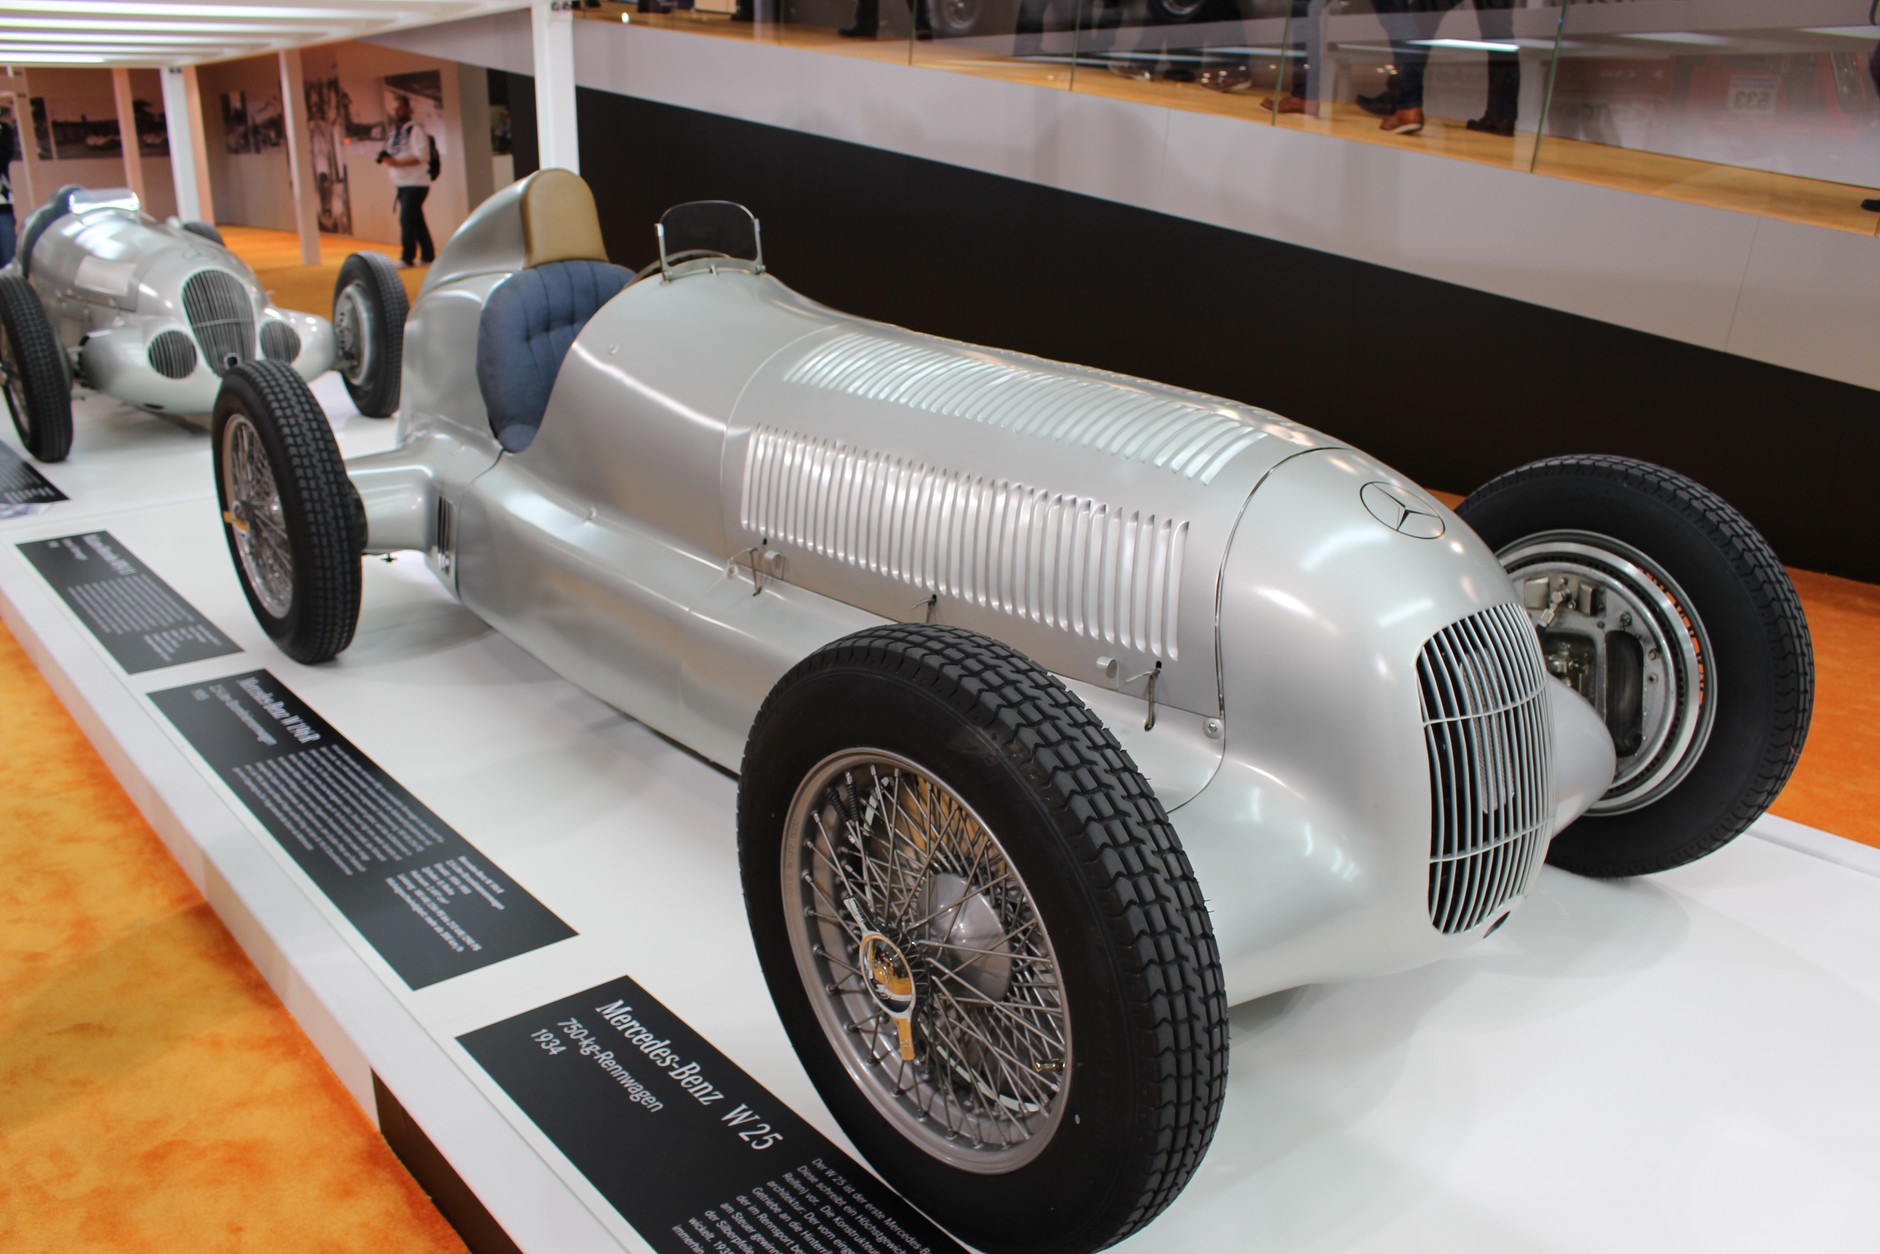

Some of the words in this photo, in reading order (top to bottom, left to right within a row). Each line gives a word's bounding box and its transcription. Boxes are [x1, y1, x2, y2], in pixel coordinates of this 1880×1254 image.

[530, 1028, 567, 1056] 1934
[556, 1017, 664, 1113] 750-kg-Rennwagen
[595, 999, 724, 1106] Mercedes-Benz
[752, 1187, 783, 1214] Getriebe
[778, 1212, 792, 1223] an
[788, 1221, 803, 1233] die
[767, 1180, 807, 1215] architektur:
[803, 1212, 821, 1226] Der
[817, 1225, 836, 1240] vorn
[782, 1172, 808, 1195] Reifen)
[805, 1191, 821, 1206] vor.
[820, 1205, 836, 1218] Die
[797, 1165, 819, 1183] Diese
[816, 1182, 847, 1207] schreibt
[843, 1204, 858, 1216] ein
[812, 1158, 828, 1171] Der
[825, 1168, 838, 1178] W
[832, 1175, 847, 1186] 25
[843, 1184, 856, 1194] ist
[852, 1192, 867, 1203] der
[865, 1203, 886, 1220] erste
[883, 1217, 932, 1254] Mercedes-B
[688, 1217, 716, 1242] wickelt.
[704, 1210, 720, 1222] der
[719, 1202, 735, 1214] am
[731, 1212, 757, 1234] Steuer
[736, 1195, 751, 1206] der
[747, 1204, 760, 1216] im
[756, 1213, 795, 1247] Rennsport
